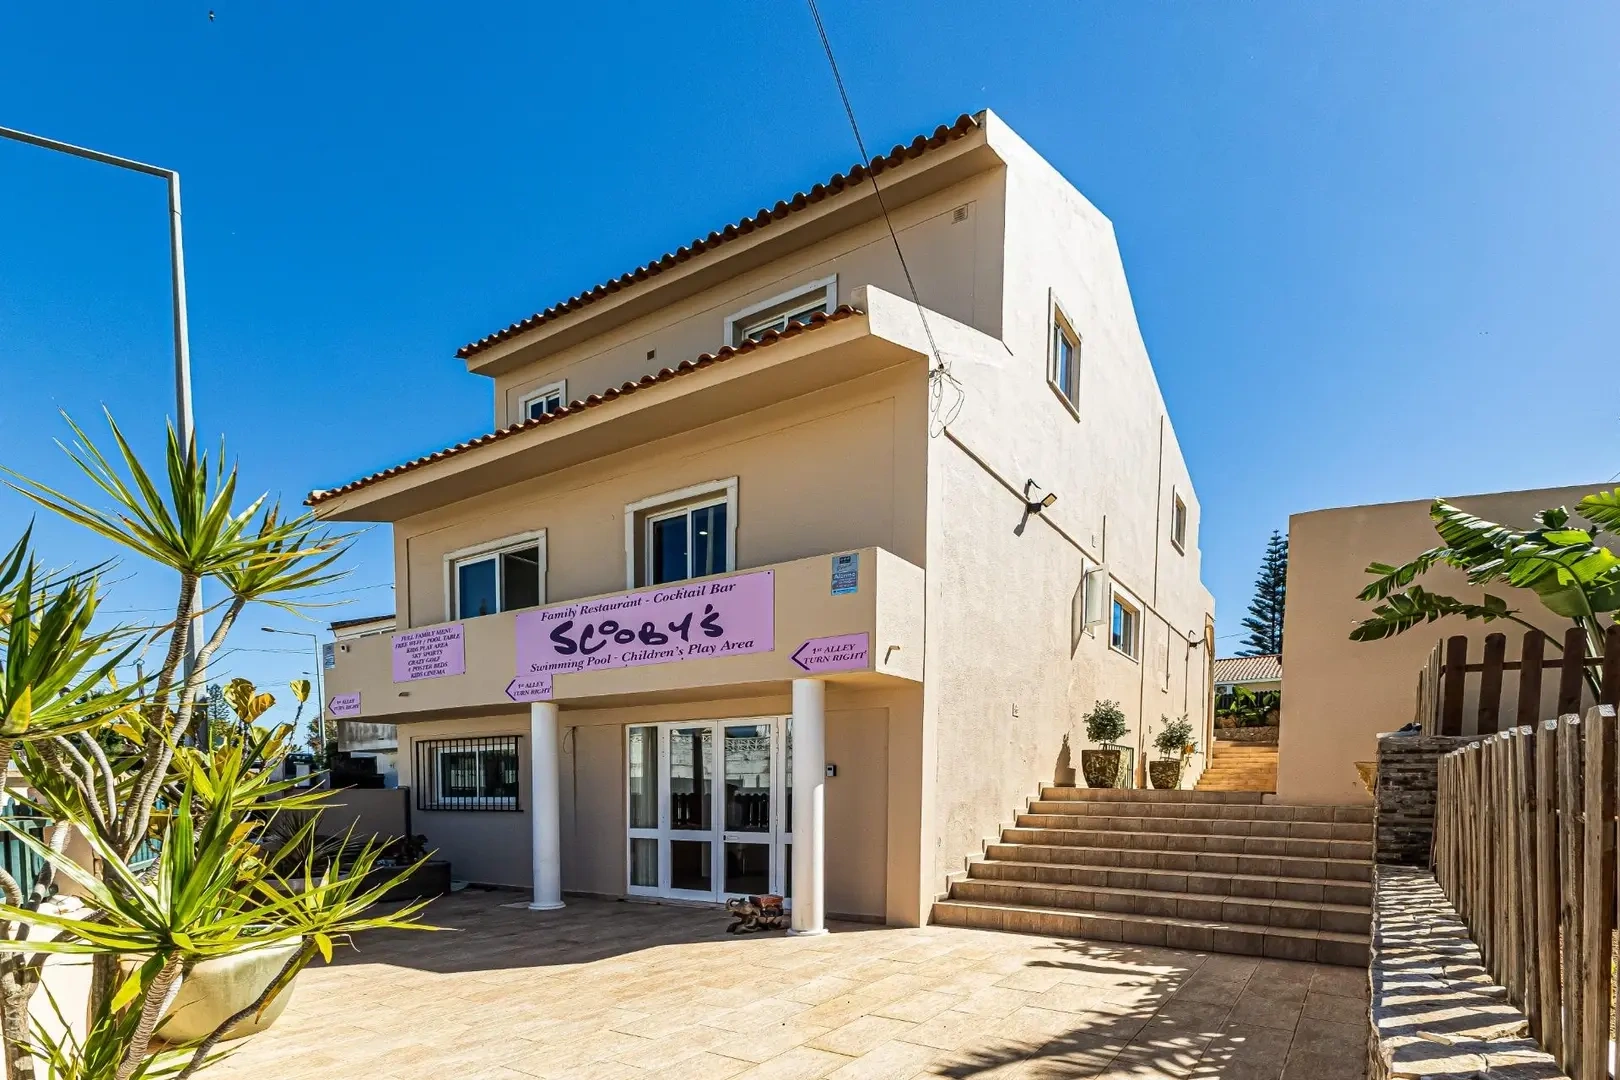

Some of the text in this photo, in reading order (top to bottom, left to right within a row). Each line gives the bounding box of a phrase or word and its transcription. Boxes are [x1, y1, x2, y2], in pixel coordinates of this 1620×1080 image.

[541, 608, 577, 621] Family
[580, 597, 642, 615] Restaurant
[653, 586, 706, 603] Cocktail
[710, 583, 736, 595] Bar
[415, 631, 435, 639] FAMILY
[423, 649, 443, 657] SPORTS
[823, 643, 856, 653] ALLEY
[530, 659, 585, 673] Swimming
[587, 654, 611, 666] Pool
[622, 647, 684, 661] Children's
[688, 643, 716, 655] Play
[720, 640, 754, 651] Area
[803, 651, 864, 664] TURN RIGHT
[412, 664, 432, 672] POSTER
